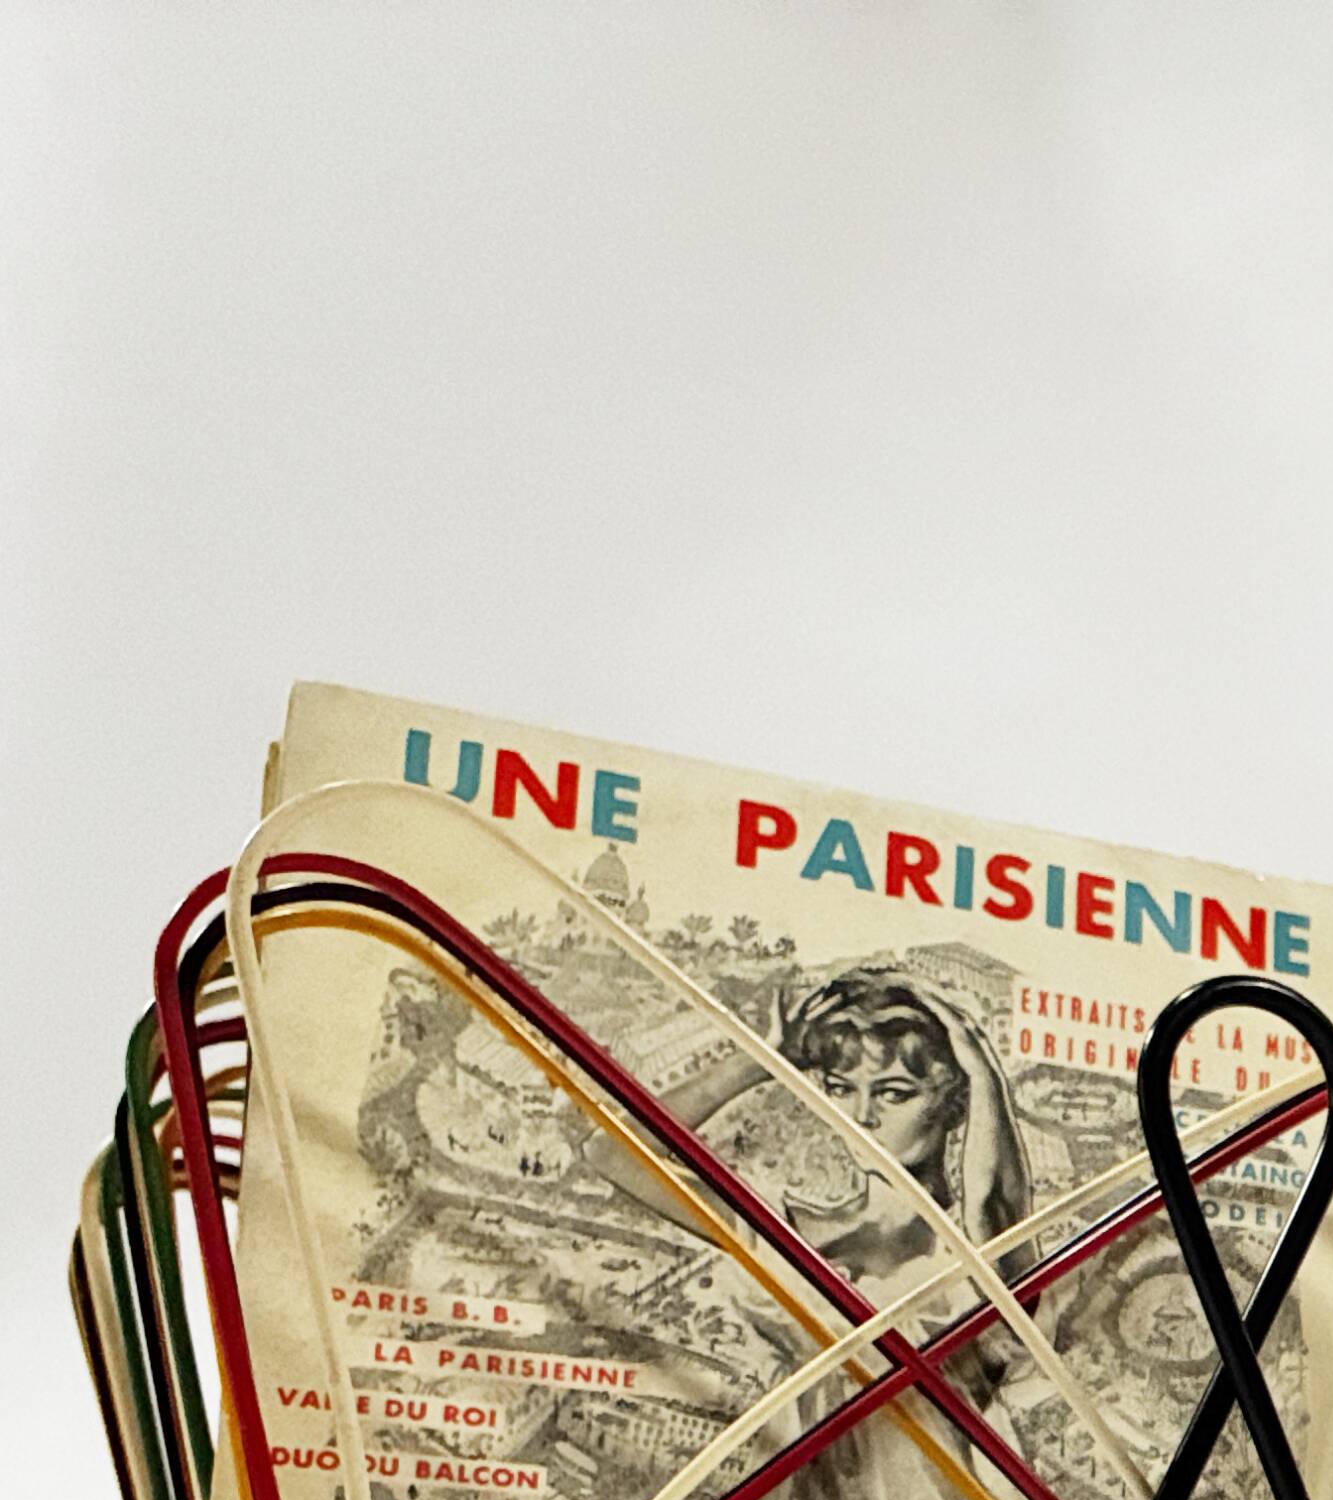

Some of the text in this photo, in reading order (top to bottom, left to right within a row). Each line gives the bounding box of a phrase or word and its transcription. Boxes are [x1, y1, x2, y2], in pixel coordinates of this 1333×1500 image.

[404, 727, 1310, 976] UNE PARISIENNE
[1021, 987, 1145, 1033] EXTRAITS
[1020, 1028, 1200, 1083] ORIGINLE
[375, 1343, 637, 1388] LA PARISIENNE
[385, 1399, 428, 1420] DU
[444, 1405, 496, 1427] ROI
[272, 1447, 340, 1471] DUO
[415, 1460, 540, 1489] BALCON
